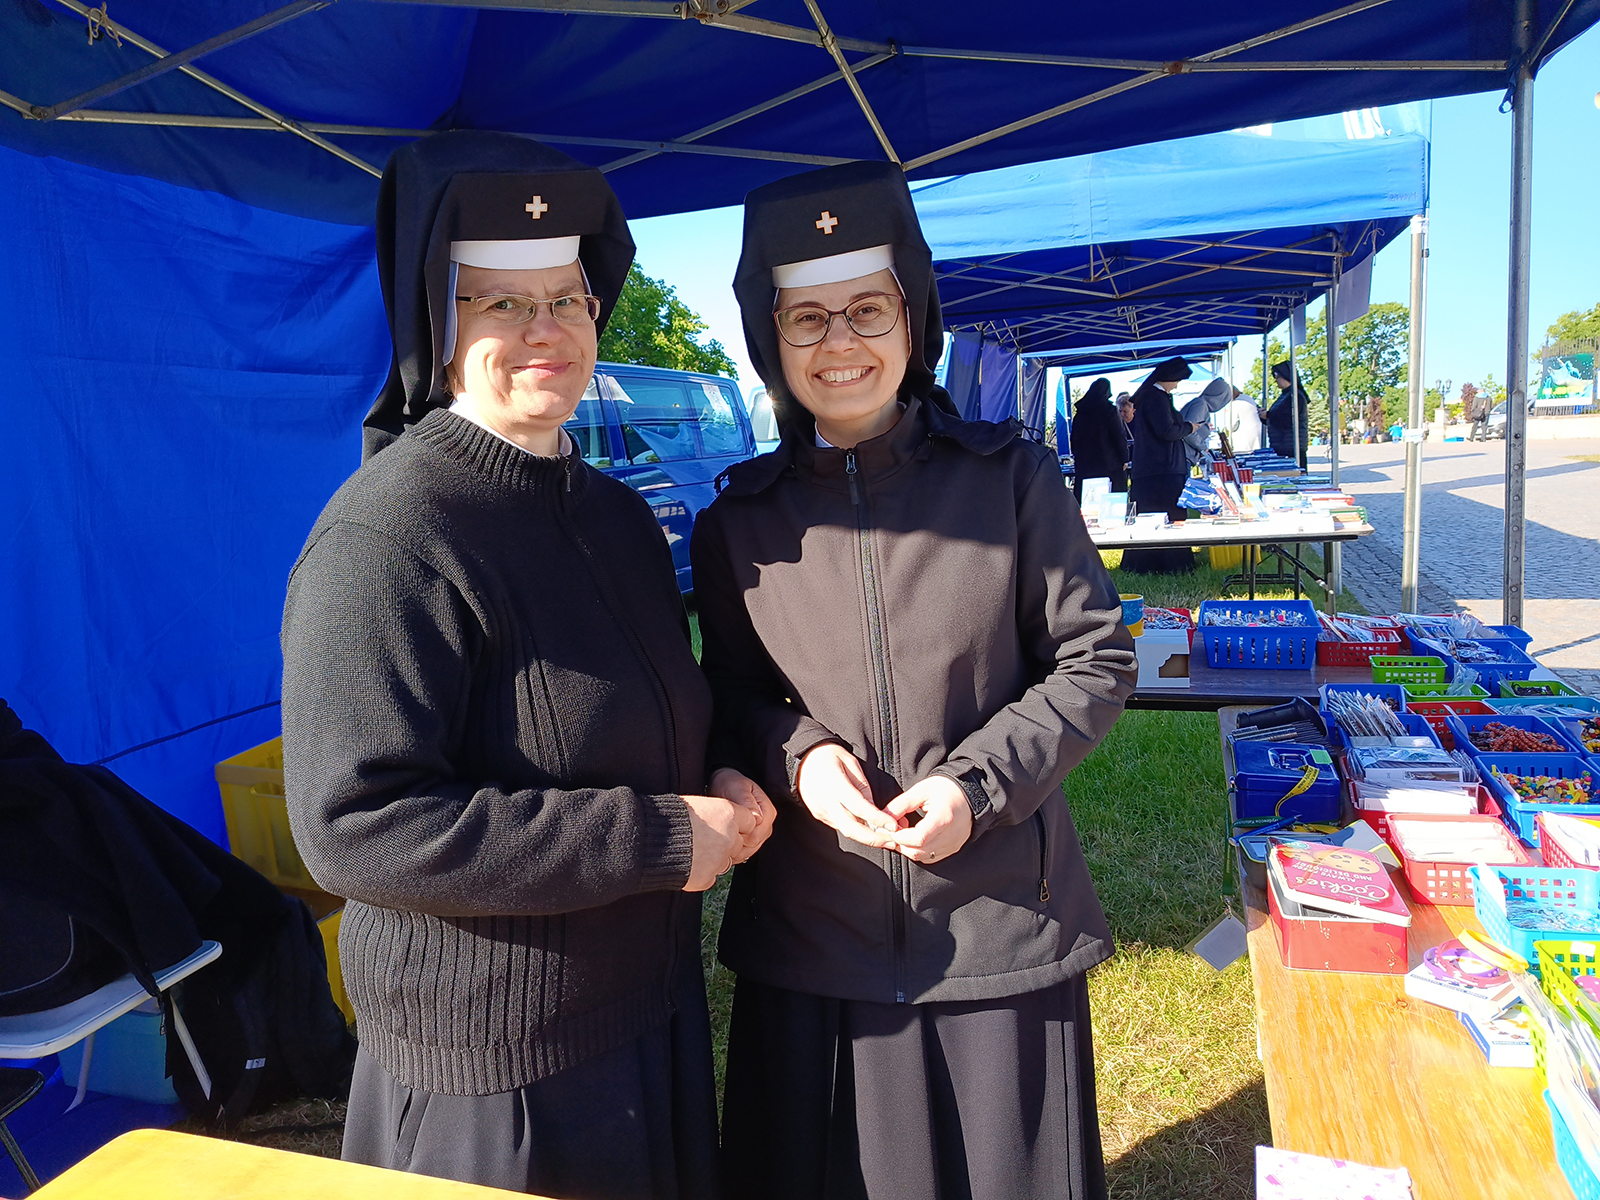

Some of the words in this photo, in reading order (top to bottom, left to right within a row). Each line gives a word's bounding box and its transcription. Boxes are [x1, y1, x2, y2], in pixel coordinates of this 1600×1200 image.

[1320, 871, 1356, 882] ALWAYS
[1353, 872, 1373, 882] AND
[1295, 876, 1390, 902] Cookies
